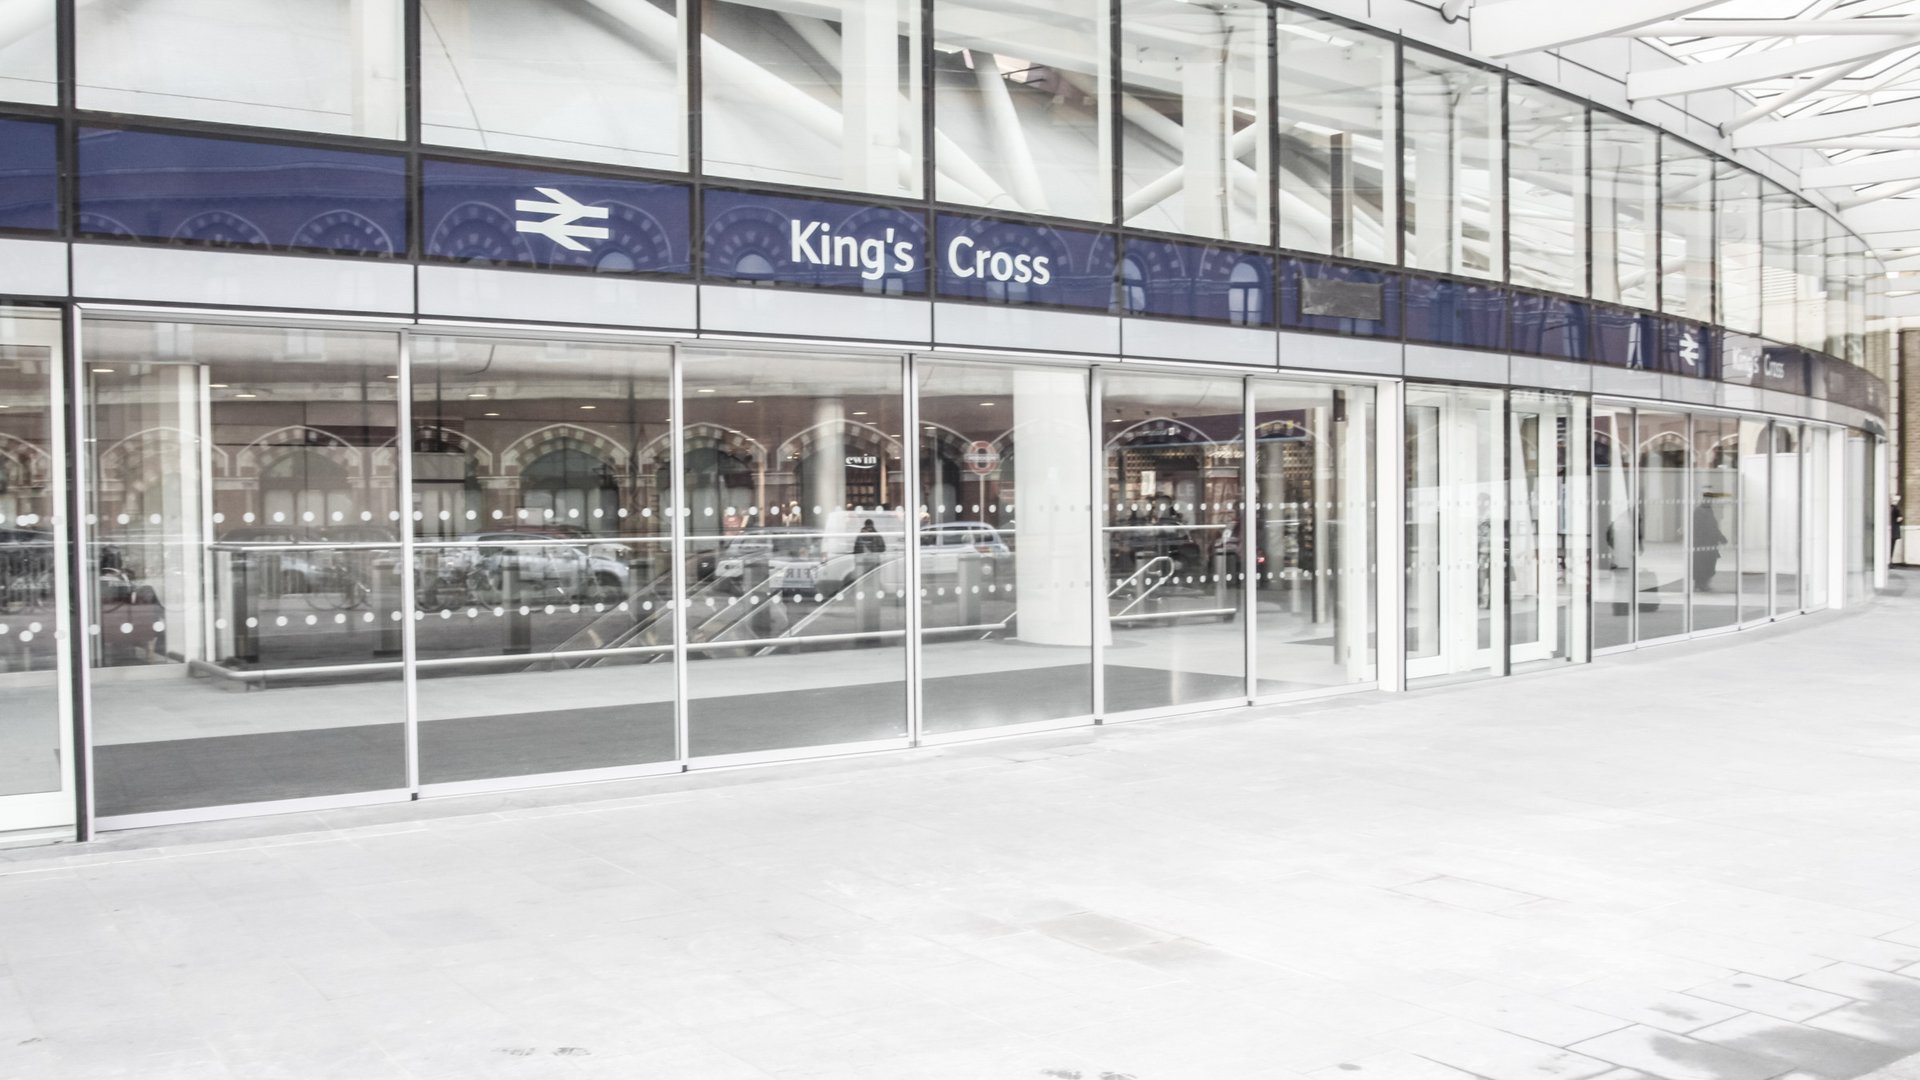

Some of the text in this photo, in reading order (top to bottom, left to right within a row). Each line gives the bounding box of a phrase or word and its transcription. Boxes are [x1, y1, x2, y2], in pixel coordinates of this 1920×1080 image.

[791, 219, 1051, 285] King's Cross
[1763, 354, 1785, 379] Cross
